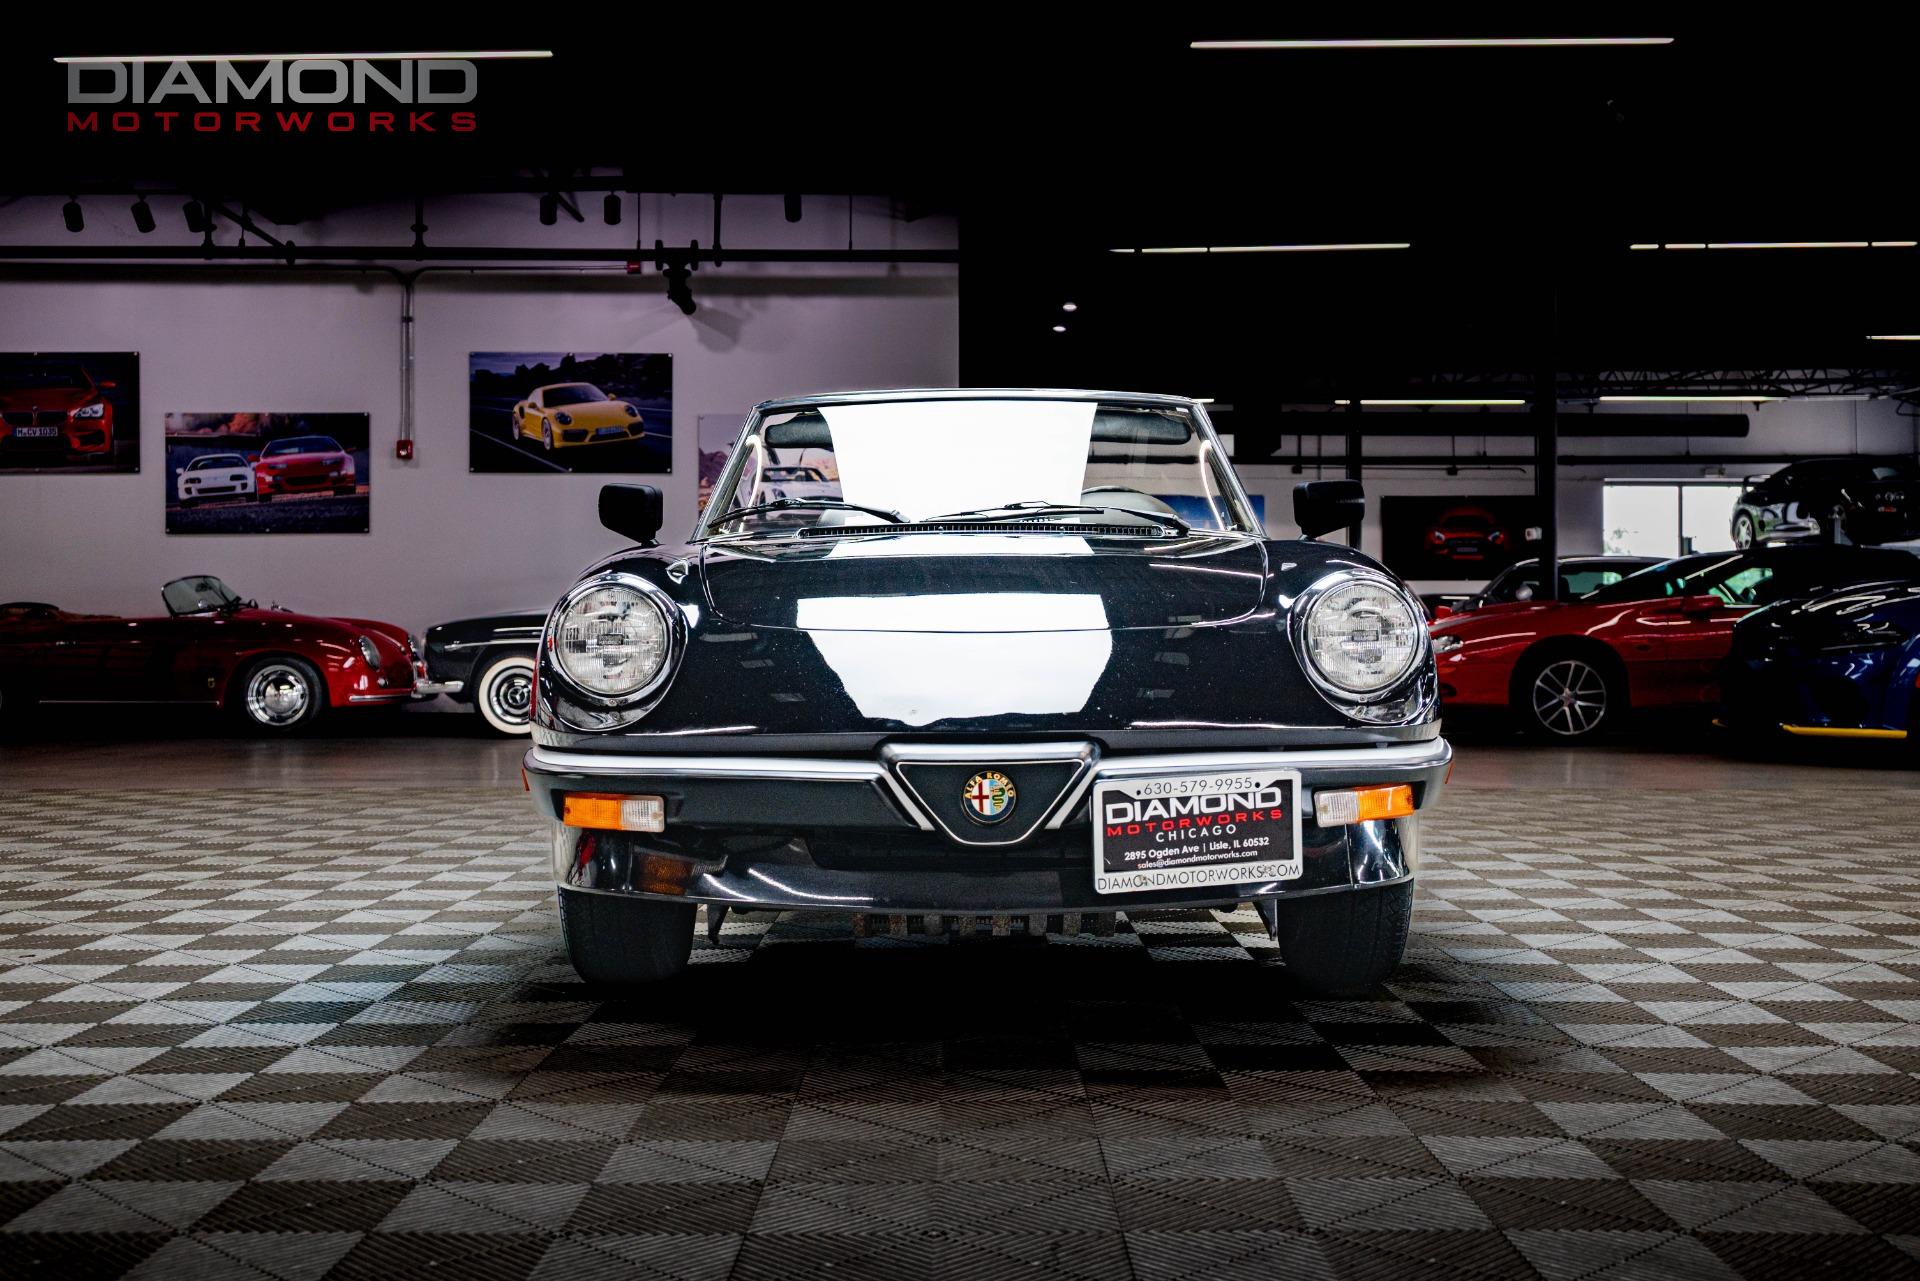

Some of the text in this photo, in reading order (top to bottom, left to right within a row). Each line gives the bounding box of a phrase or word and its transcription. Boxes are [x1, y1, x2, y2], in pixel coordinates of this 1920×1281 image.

[964, 772, 1015, 800] ALFA ROMEO
[1143, 776, 1253, 796] 630-579-9955
[1105, 787, 1282, 825] DIAMOND
[1106, 809, 1284, 838] MOTORWORKS
[1155, 824, 1237, 843] CHICAGO
[1124, 850, 1147, 861] 2895
[1148, 846, 1180, 860] Ogden
[1181, 844, 1200, 856] Ave
[1233, 839, 1241, 849] IL
[1242, 836, 1270, 848] 60532
[1137, 849, 1259, 870] sales@diamondmotorworks.com
[1097, 863, 1301, 891] DIAMONDMOTORWORKS.COM
